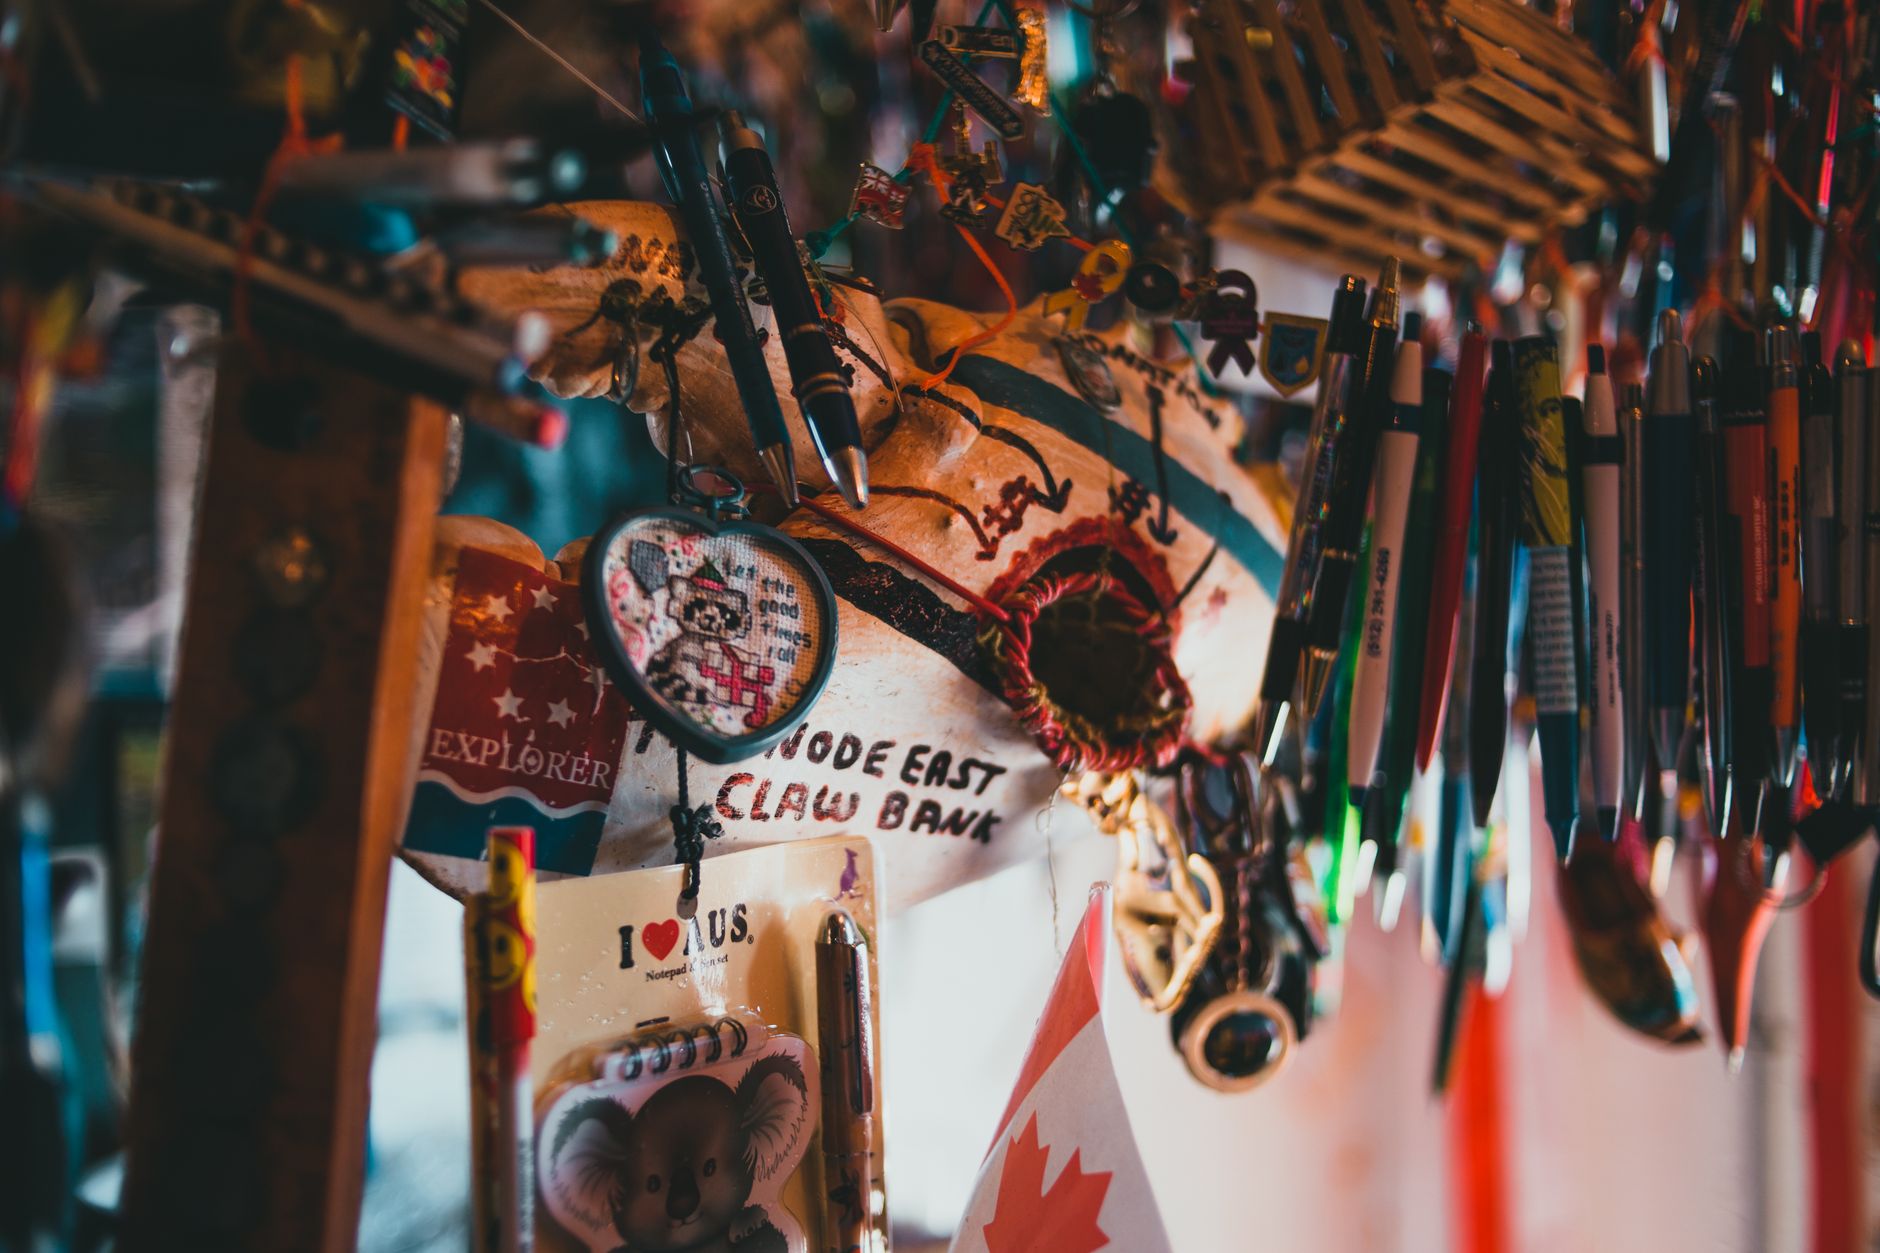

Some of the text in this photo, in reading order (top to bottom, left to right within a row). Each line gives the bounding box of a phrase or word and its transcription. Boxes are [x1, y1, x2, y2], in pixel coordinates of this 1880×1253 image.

[429, 727, 612, 790] EXPLORER
[900, 743, 1008, 797] EAST
[715, 771, 1002, 844] CLAW BANK
[619, 924, 635, 970] I
[645, 963, 687, 981] Notepad
